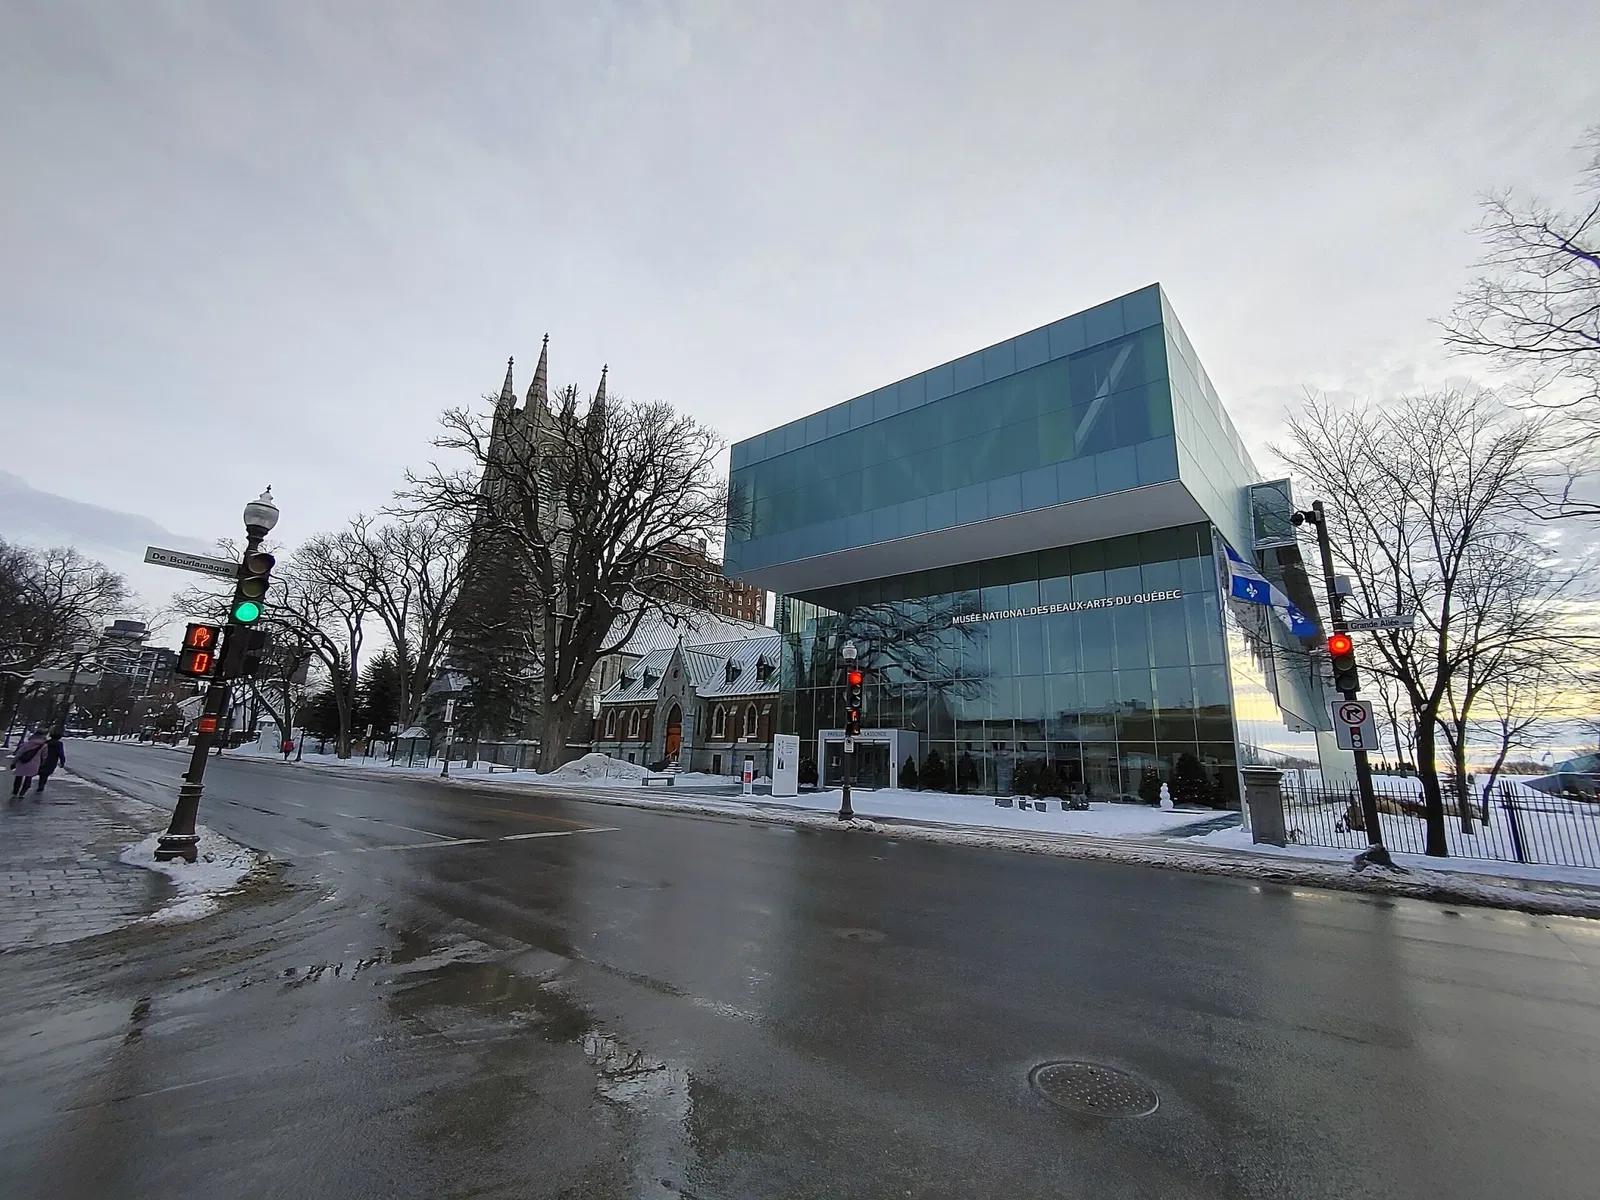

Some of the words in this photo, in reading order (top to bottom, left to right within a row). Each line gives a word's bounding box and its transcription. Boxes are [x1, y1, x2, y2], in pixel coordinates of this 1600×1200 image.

[152, 552, 166, 561] De
[170, 555, 230, 573] Bourlamaque
[952, 612, 980, 625] MUSÉE
[982, 608, 1029, 621] NATIONAL
[1030, 605, 1048, 615] DES
[1050, 597, 1114, 613] BEAUX-ARTS
[1116, 595, 1132, 605] DU
[1134, 589, 1182, 604] QUÉBEC
[1350, 620, 1379, 630] Grande
